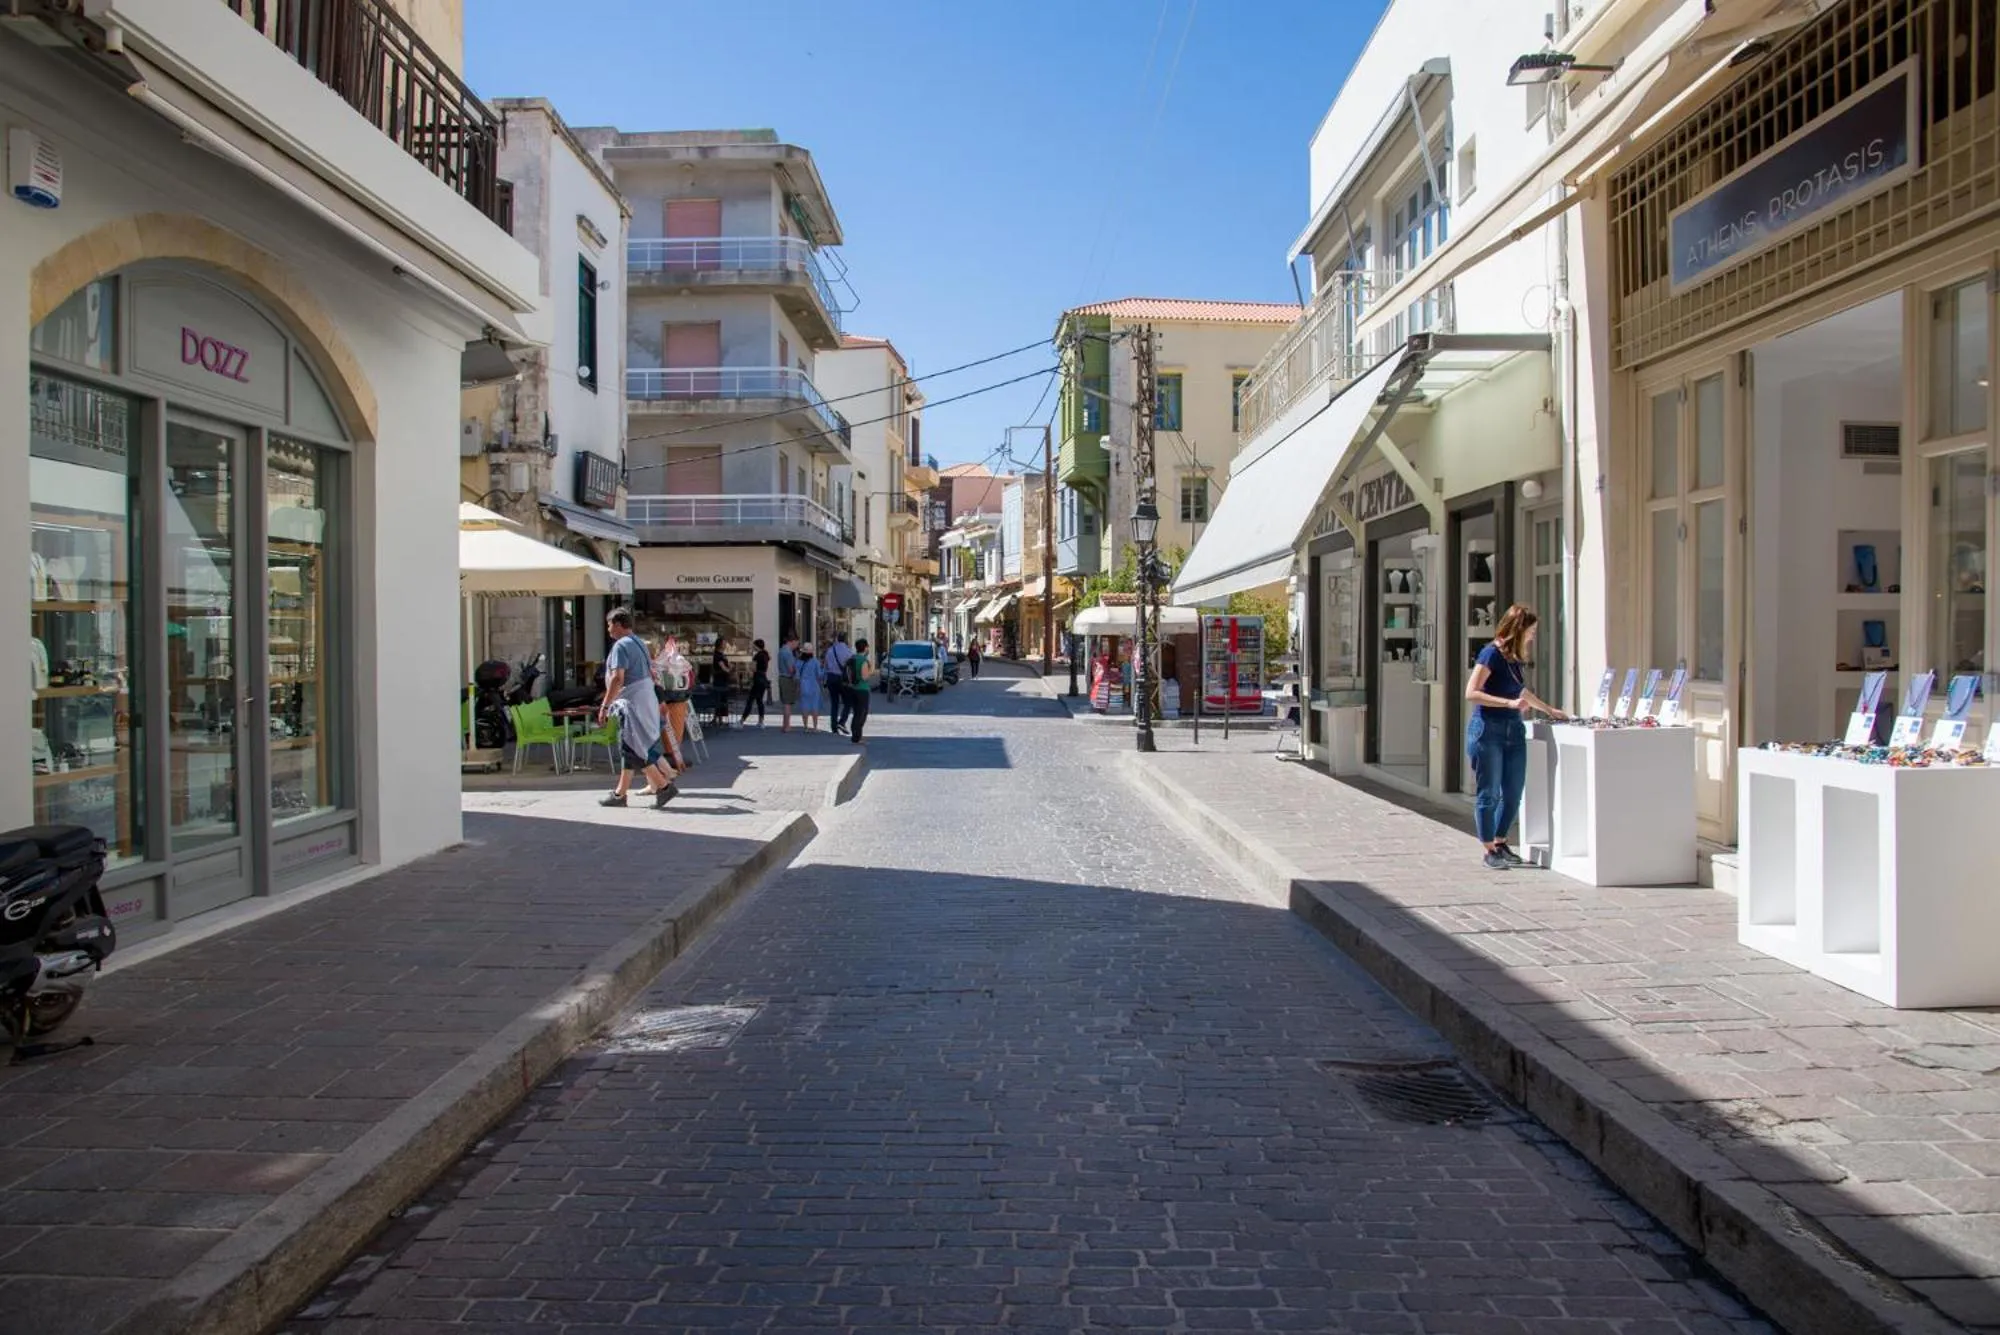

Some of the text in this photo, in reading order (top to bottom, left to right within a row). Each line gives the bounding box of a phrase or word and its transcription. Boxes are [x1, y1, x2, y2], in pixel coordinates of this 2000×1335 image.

[1687, 138, 1884, 268] ATHENS PROTASIS
[181, 326, 250, 383] DOZZ
